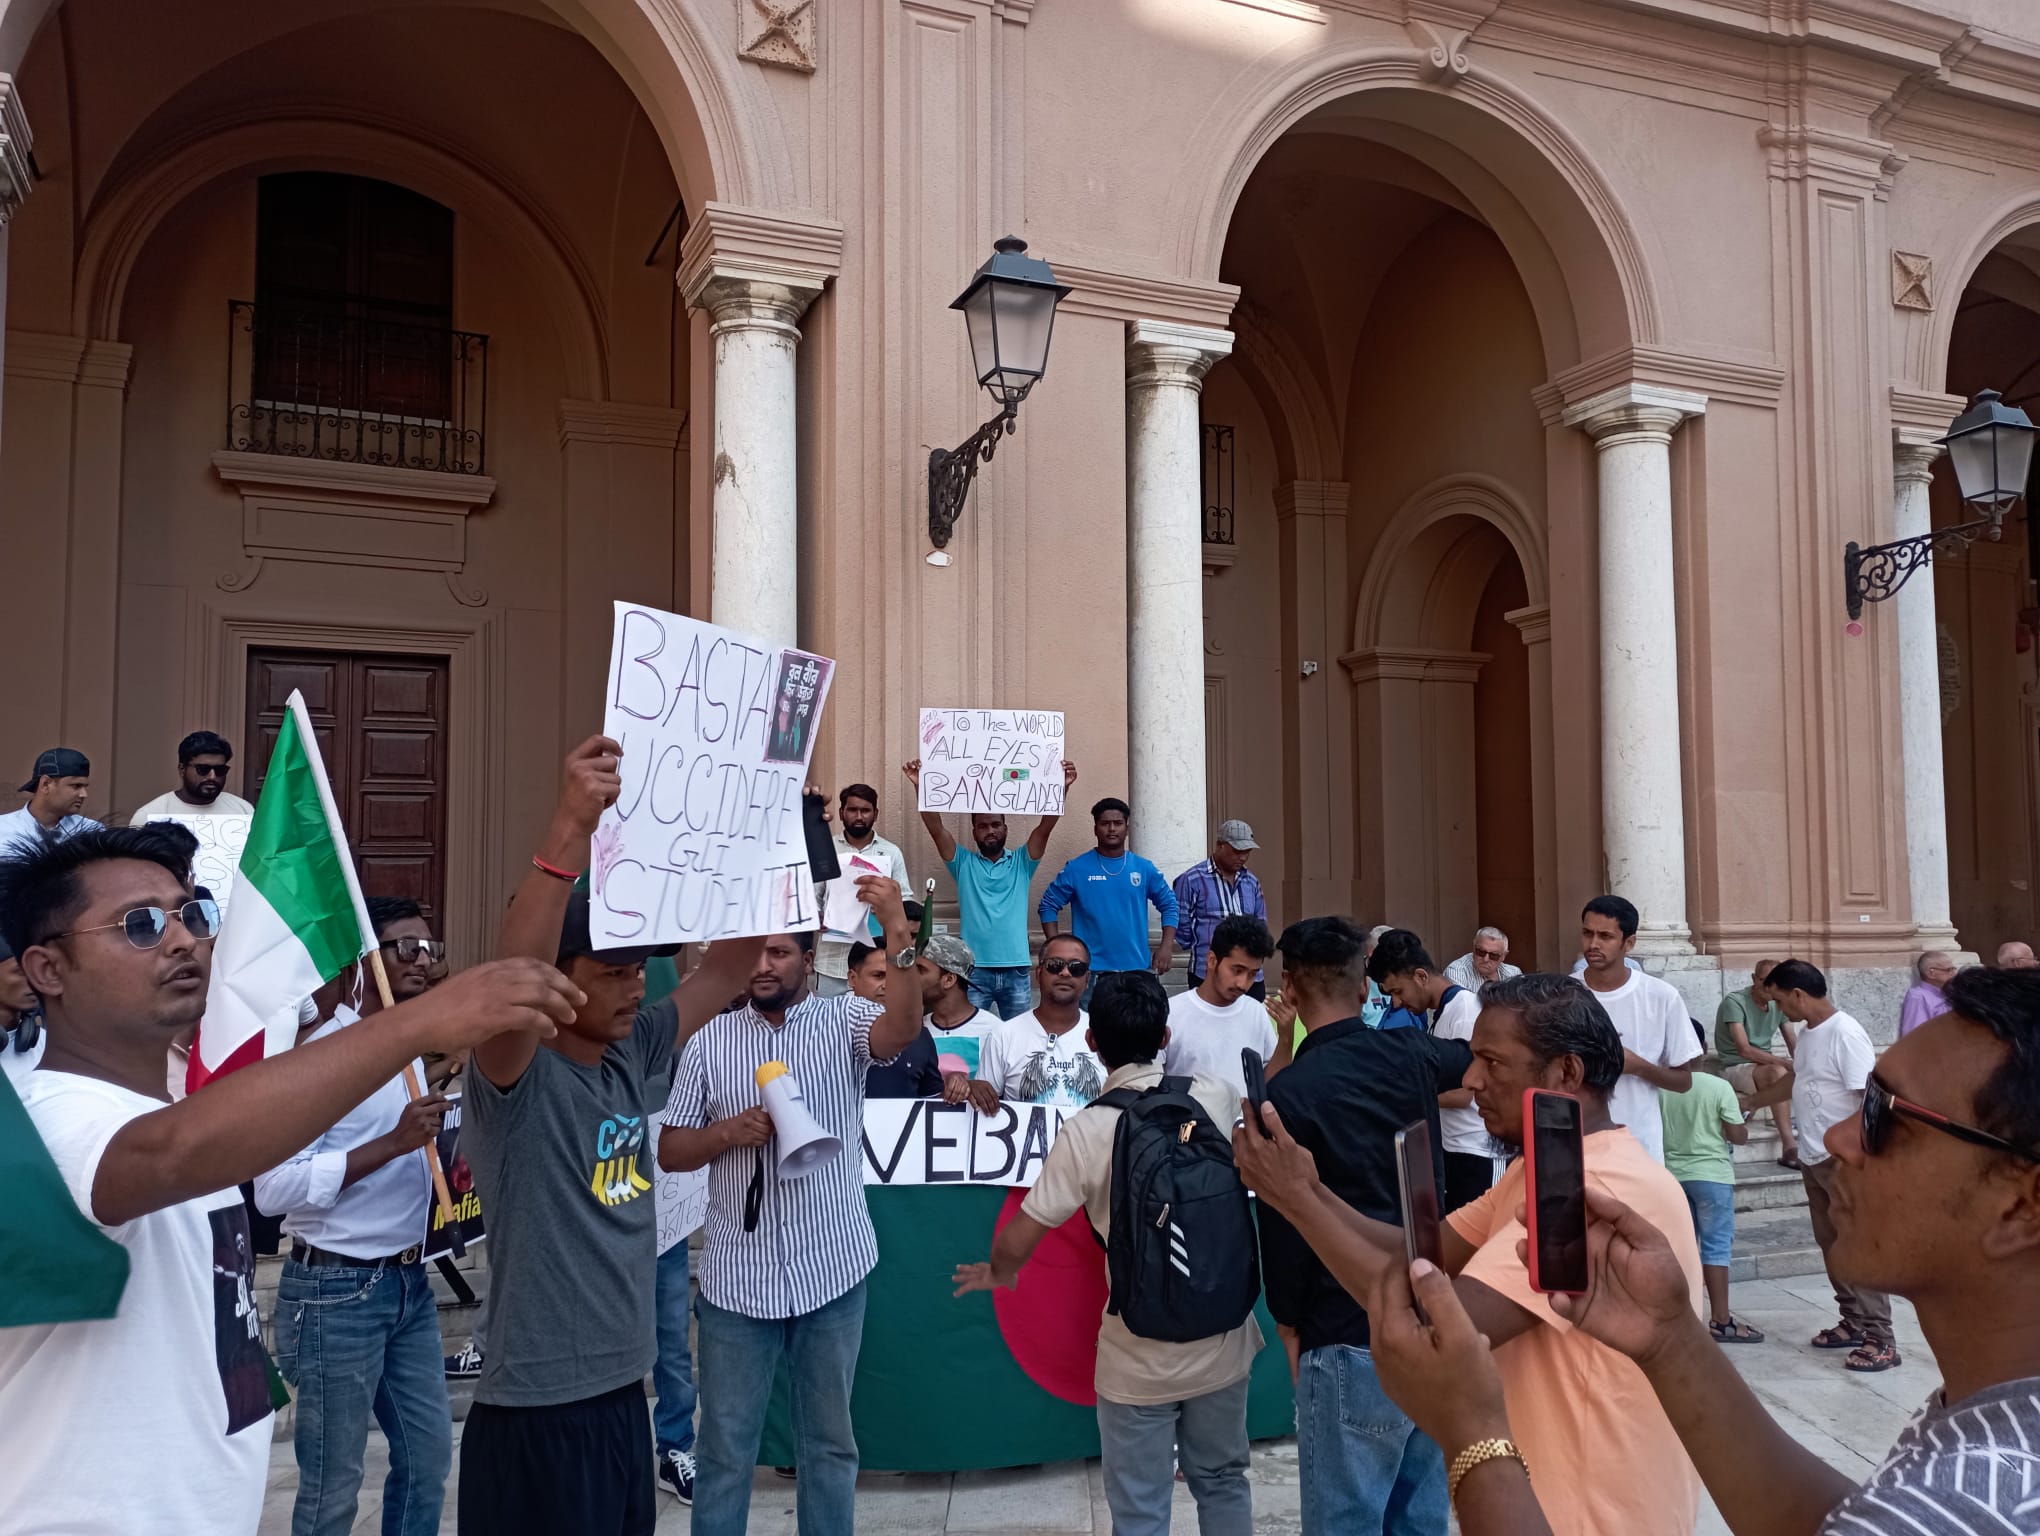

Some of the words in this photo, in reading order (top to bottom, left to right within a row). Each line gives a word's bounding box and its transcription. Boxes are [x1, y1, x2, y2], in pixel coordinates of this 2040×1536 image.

[615, 610, 773, 750] BASTA
[1013, 711, 1064, 739] WORLD
[928, 736, 974, 761] ALL
[984, 736, 1041, 768] EYES
[966, 764, 996, 781] ON
[615, 732, 798, 852] UCCIDERE
[668, 832, 730, 877] GLI
[603, 859, 813, 939] STUDENTI
[1046, 1056, 1075, 1073] Angel
